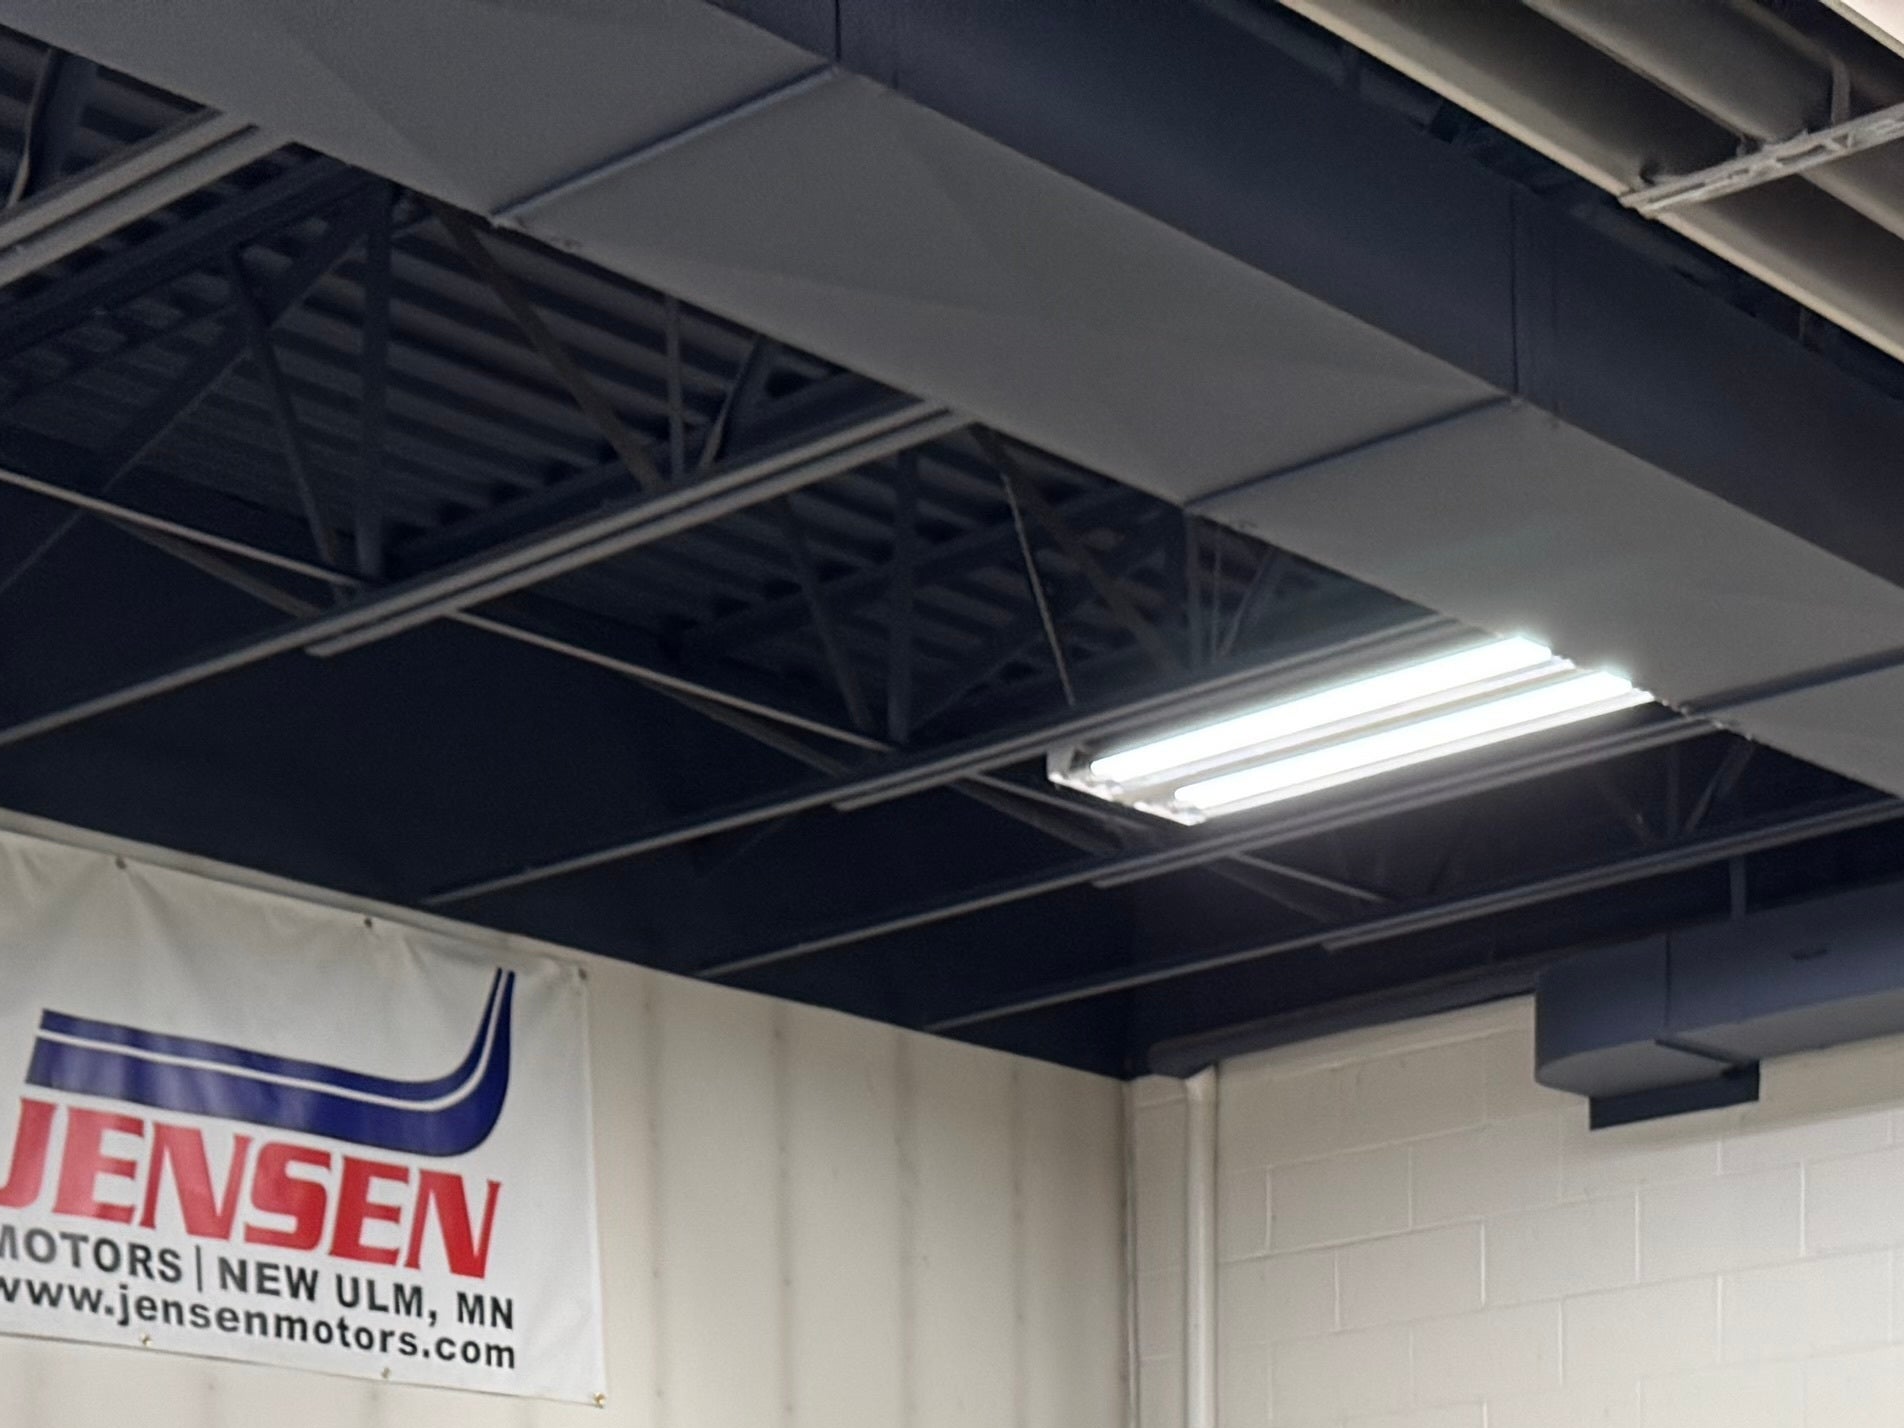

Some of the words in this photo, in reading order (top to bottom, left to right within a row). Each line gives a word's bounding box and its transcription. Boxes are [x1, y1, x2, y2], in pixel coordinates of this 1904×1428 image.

[218, 1256, 320, 1303] NEW
[335, 1273, 437, 1326] ULM,
[456, 1292, 515, 1331] MN
